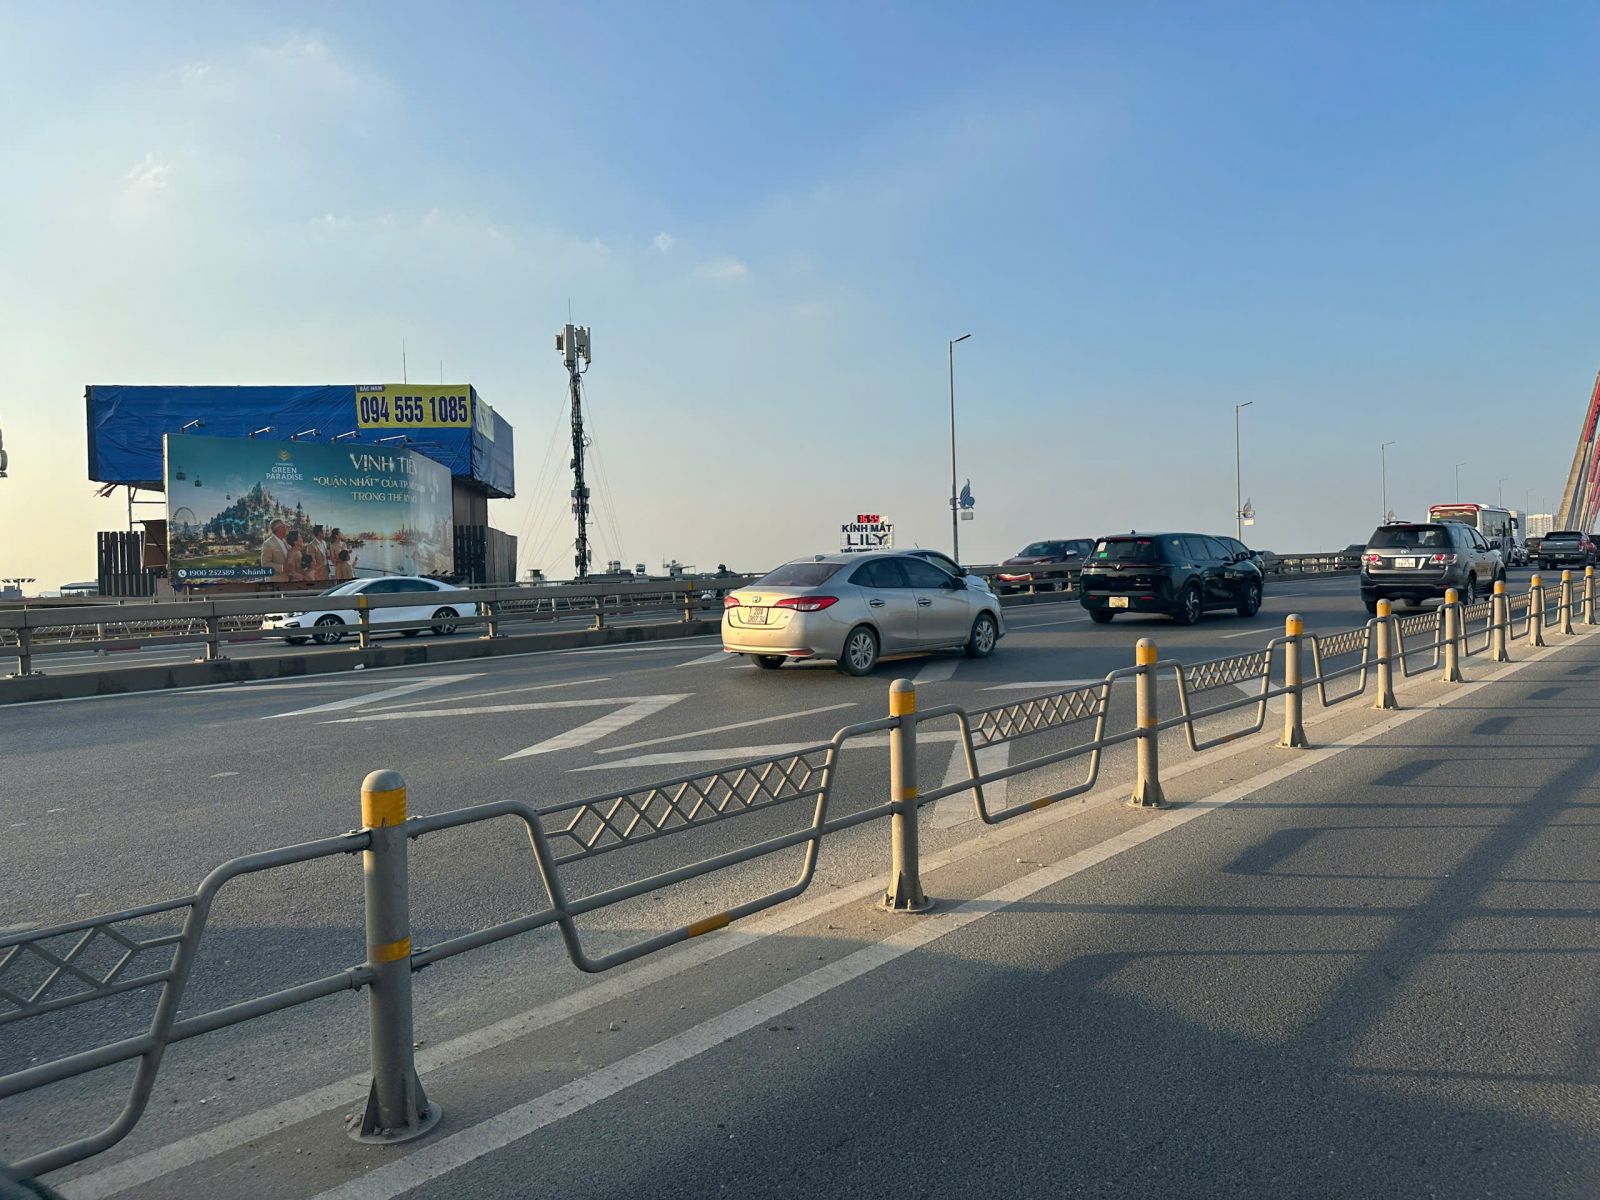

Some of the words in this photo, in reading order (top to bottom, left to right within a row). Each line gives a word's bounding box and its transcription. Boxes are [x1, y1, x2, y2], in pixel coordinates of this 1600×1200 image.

[360, 396, 390, 424] 094
[394, 396, 424, 423] 555
[429, 395, 468, 423] 1085
[349, 452, 395, 473] VỊNH
[271, 466, 297, 474] GREEN
[266, 472, 304, 481] PARADISE
[381, 477, 399, 488] CỦA
[351, 491, 386, 502] TRONG
[841, 522, 868, 533] KÍNH
[846, 533, 889, 546] LILY
[189, 569, 207, 577] 1900
